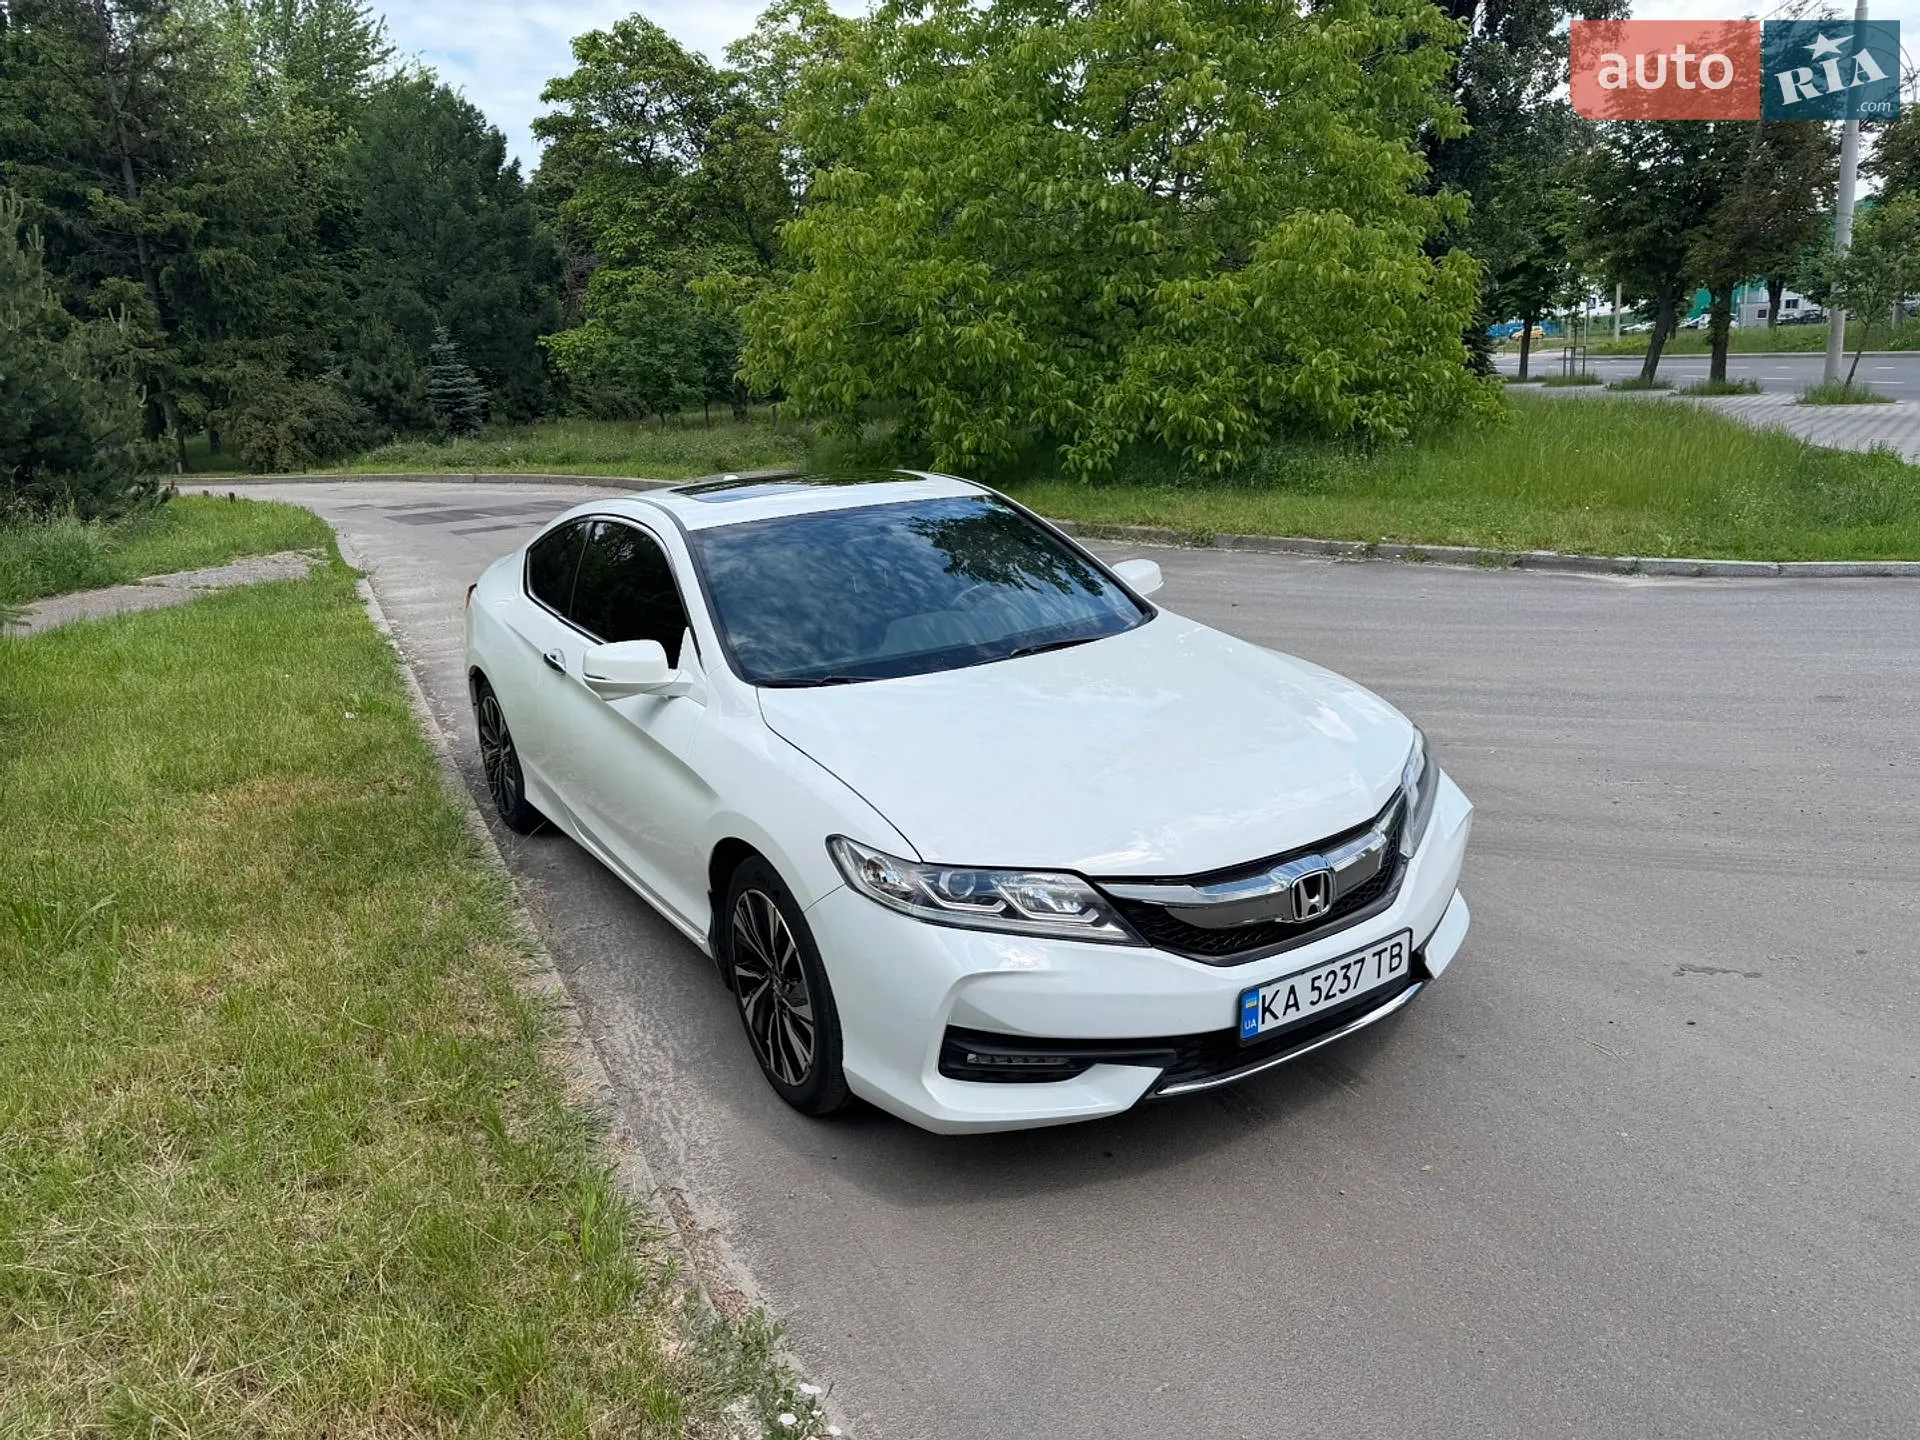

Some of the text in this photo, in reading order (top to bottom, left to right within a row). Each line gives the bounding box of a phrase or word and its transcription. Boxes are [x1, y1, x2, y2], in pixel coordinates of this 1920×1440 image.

[1261, 942, 1403, 1025] KA 5237 TB
[1244, 1020, 1257, 1030] UA
